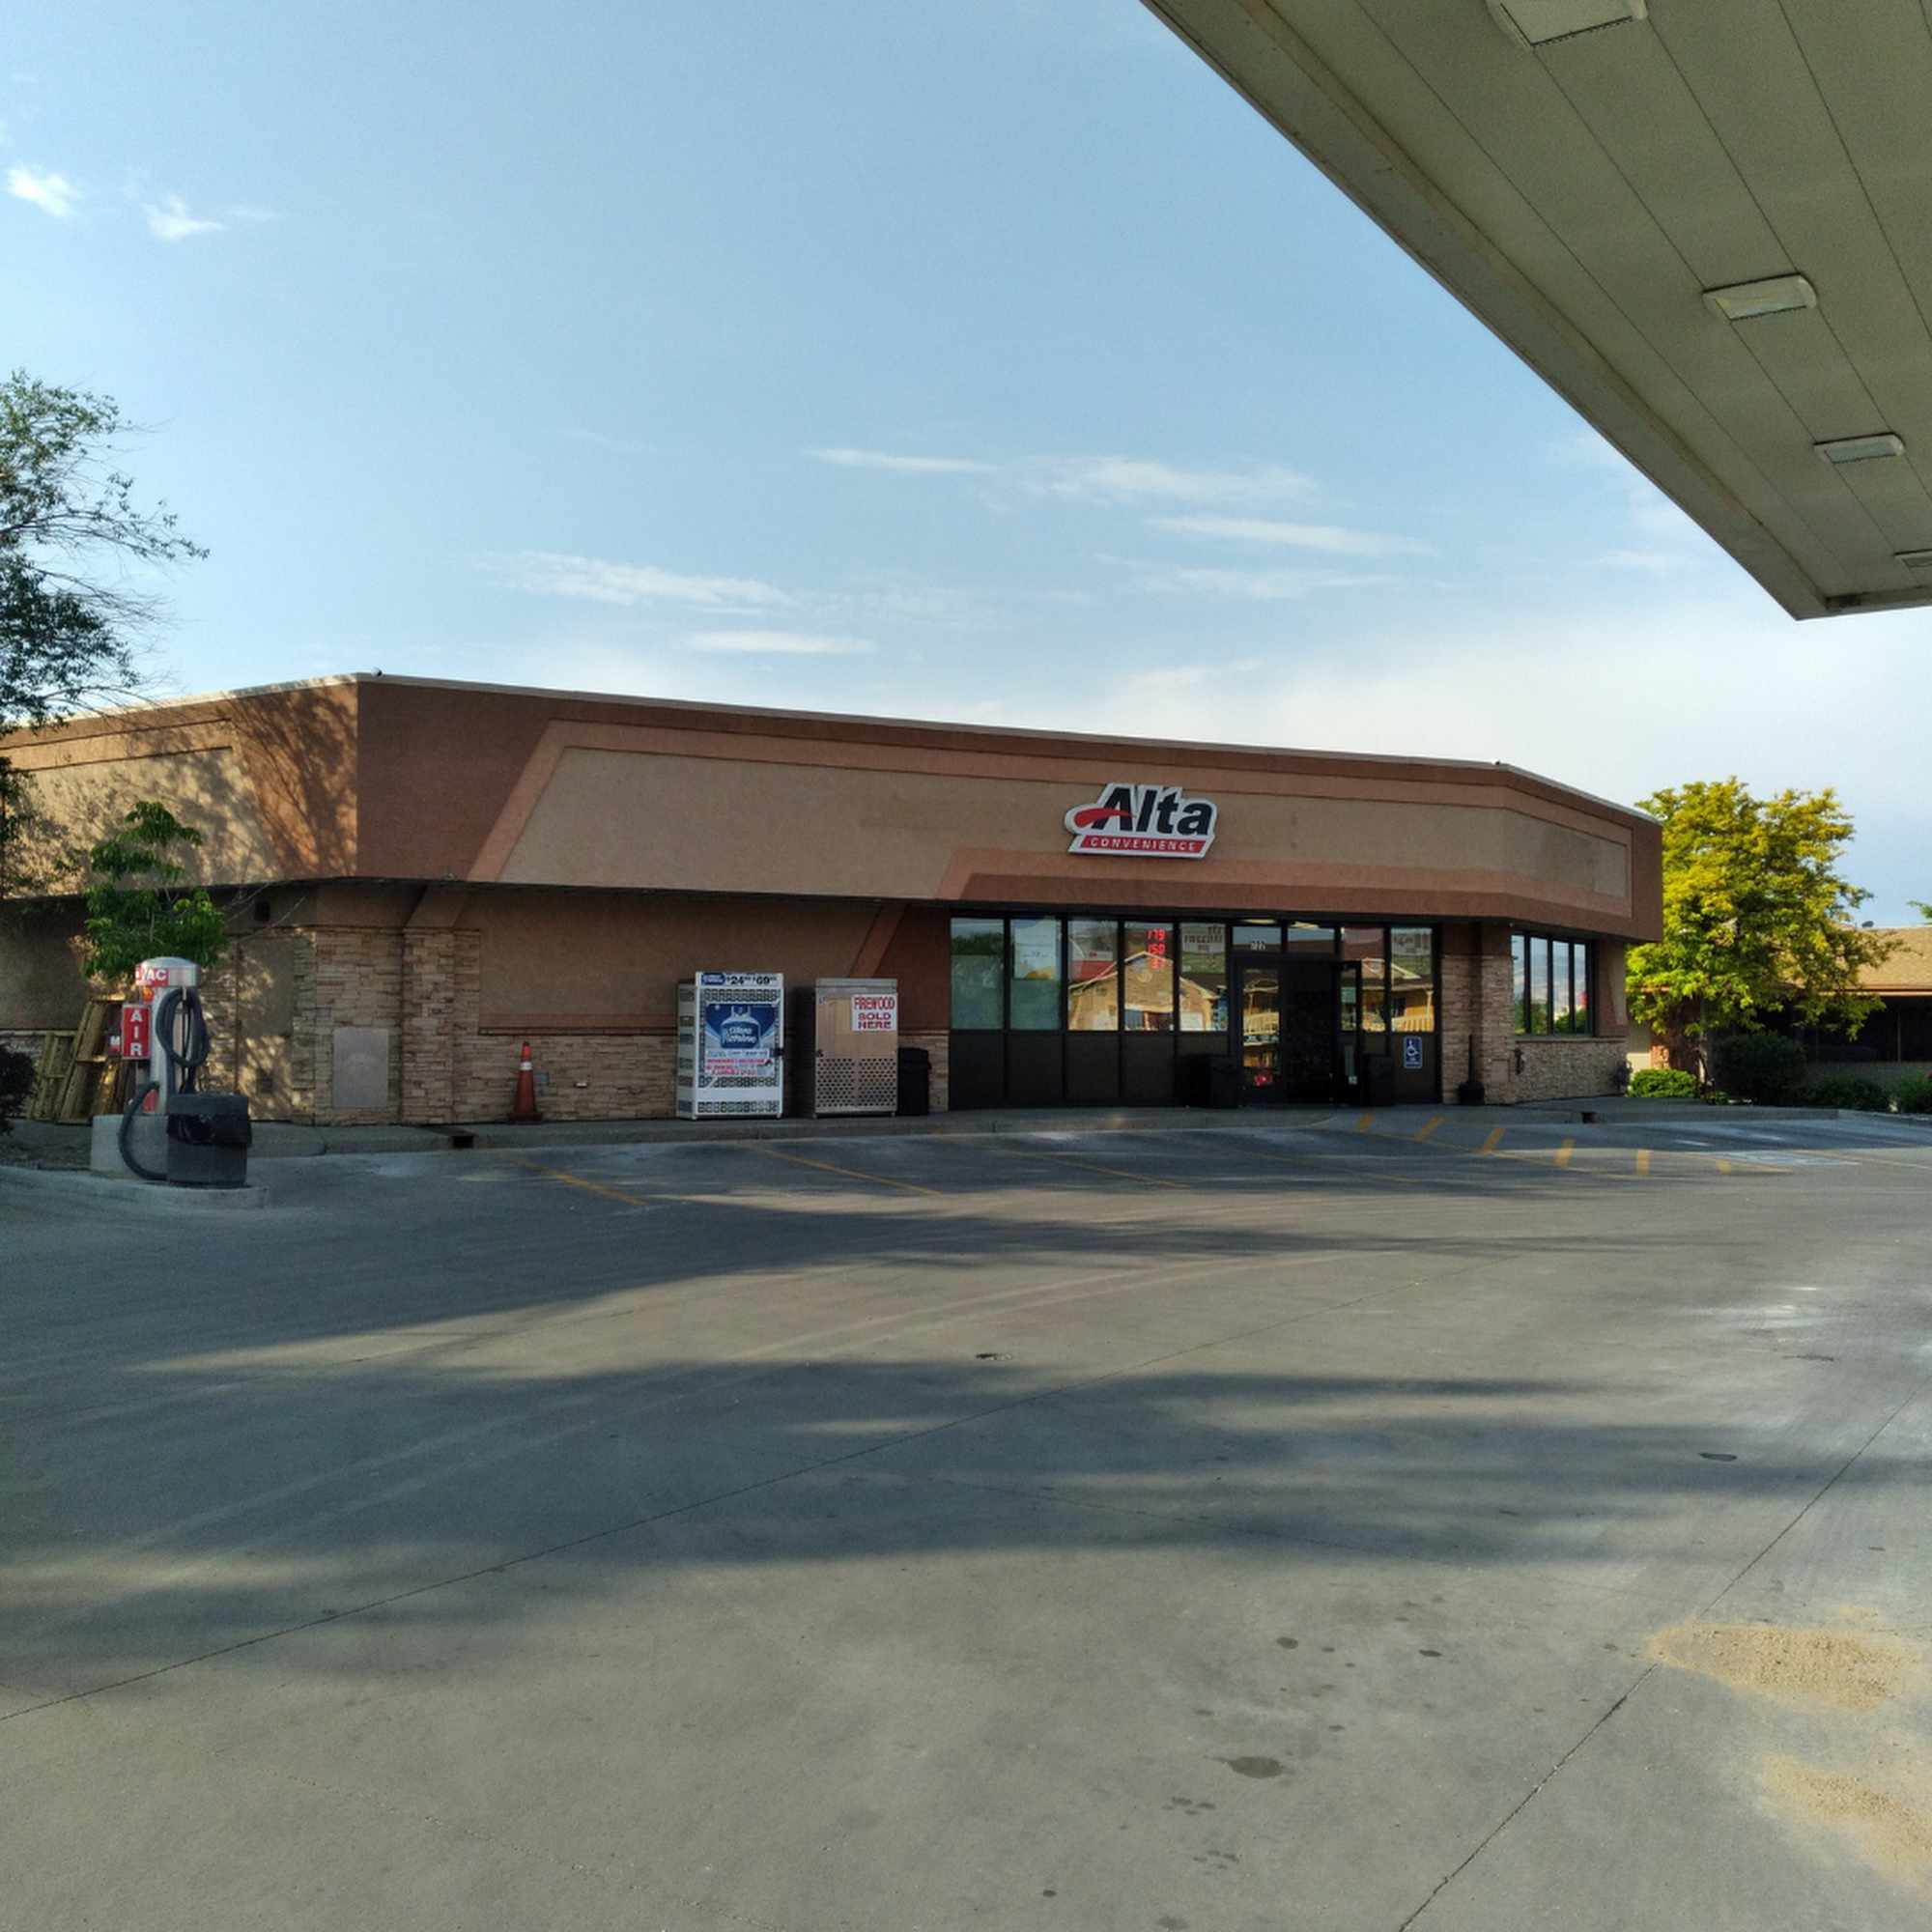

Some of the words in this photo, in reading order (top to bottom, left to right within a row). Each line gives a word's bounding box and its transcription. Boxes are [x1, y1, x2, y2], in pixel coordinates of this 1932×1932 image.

[1090, 786, 1212, 836] Alta
[1090, 837, 1196, 852] CONVENIENCE
[854, 996, 895, 1010] FIREWOOD
[129, 1009, 143, 1057] AIR
